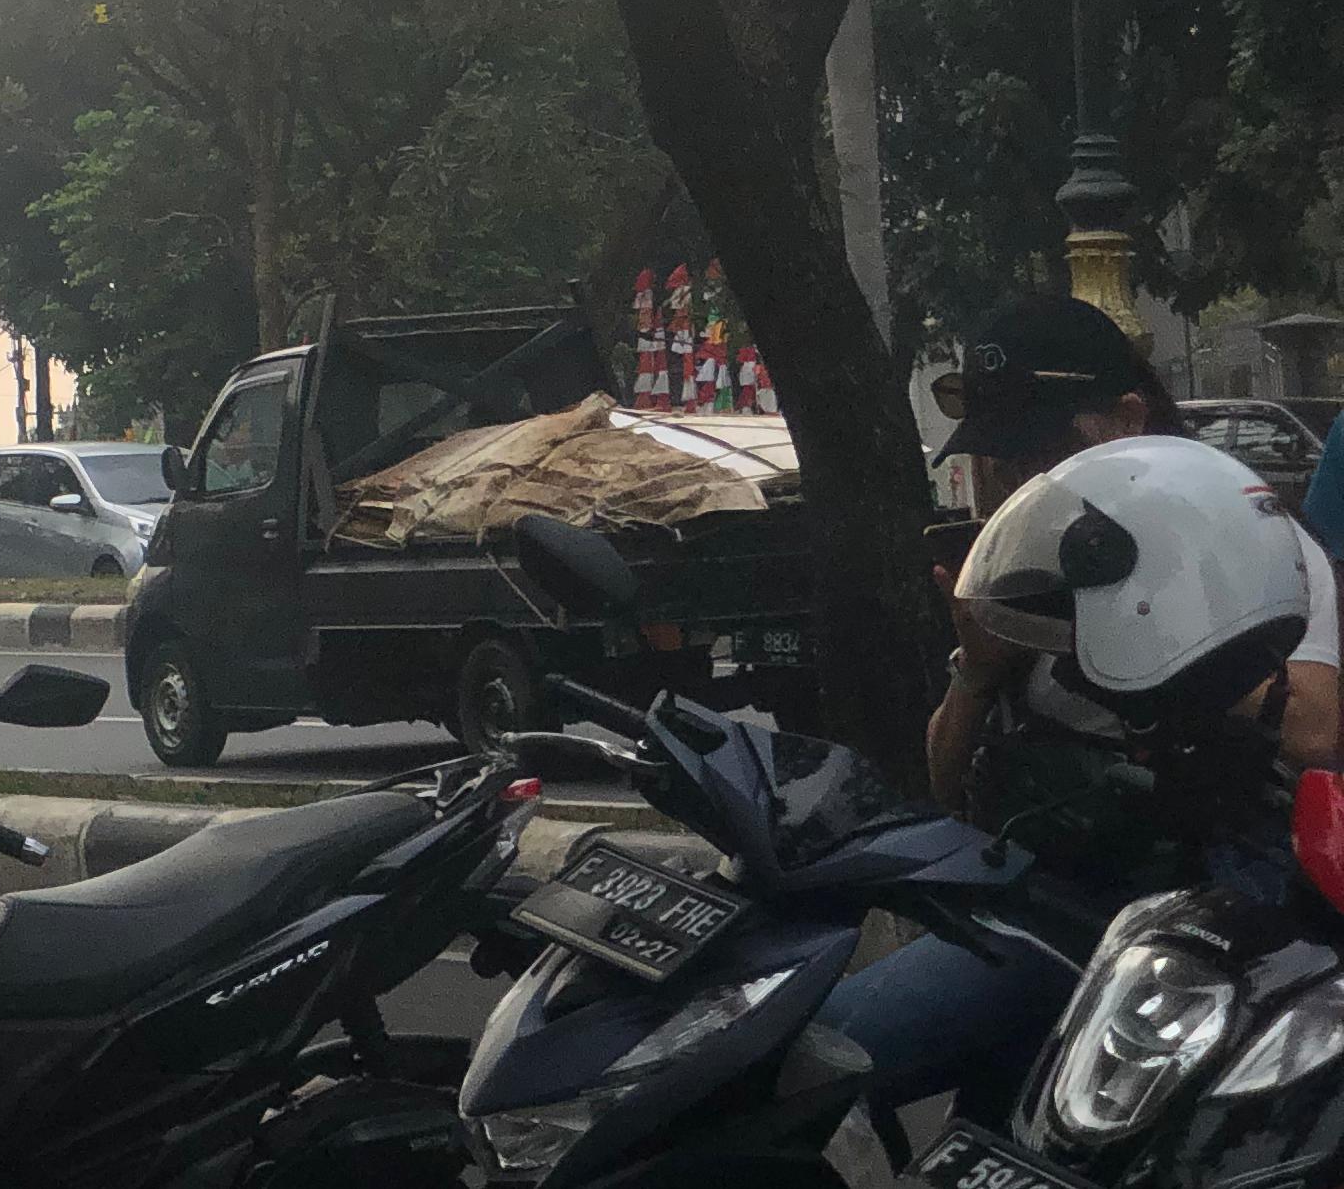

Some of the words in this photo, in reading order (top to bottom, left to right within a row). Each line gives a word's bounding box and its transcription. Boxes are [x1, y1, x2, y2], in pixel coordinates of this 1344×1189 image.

[567, 857, 605, 882] F
[591, 866, 667, 911] 3923
[658, 895, 727, 937] FHE
[1173, 922, 1231, 952] HONDA
[919, 1140, 969, 1173] F
[956, 1157, 1050, 1189] 59
